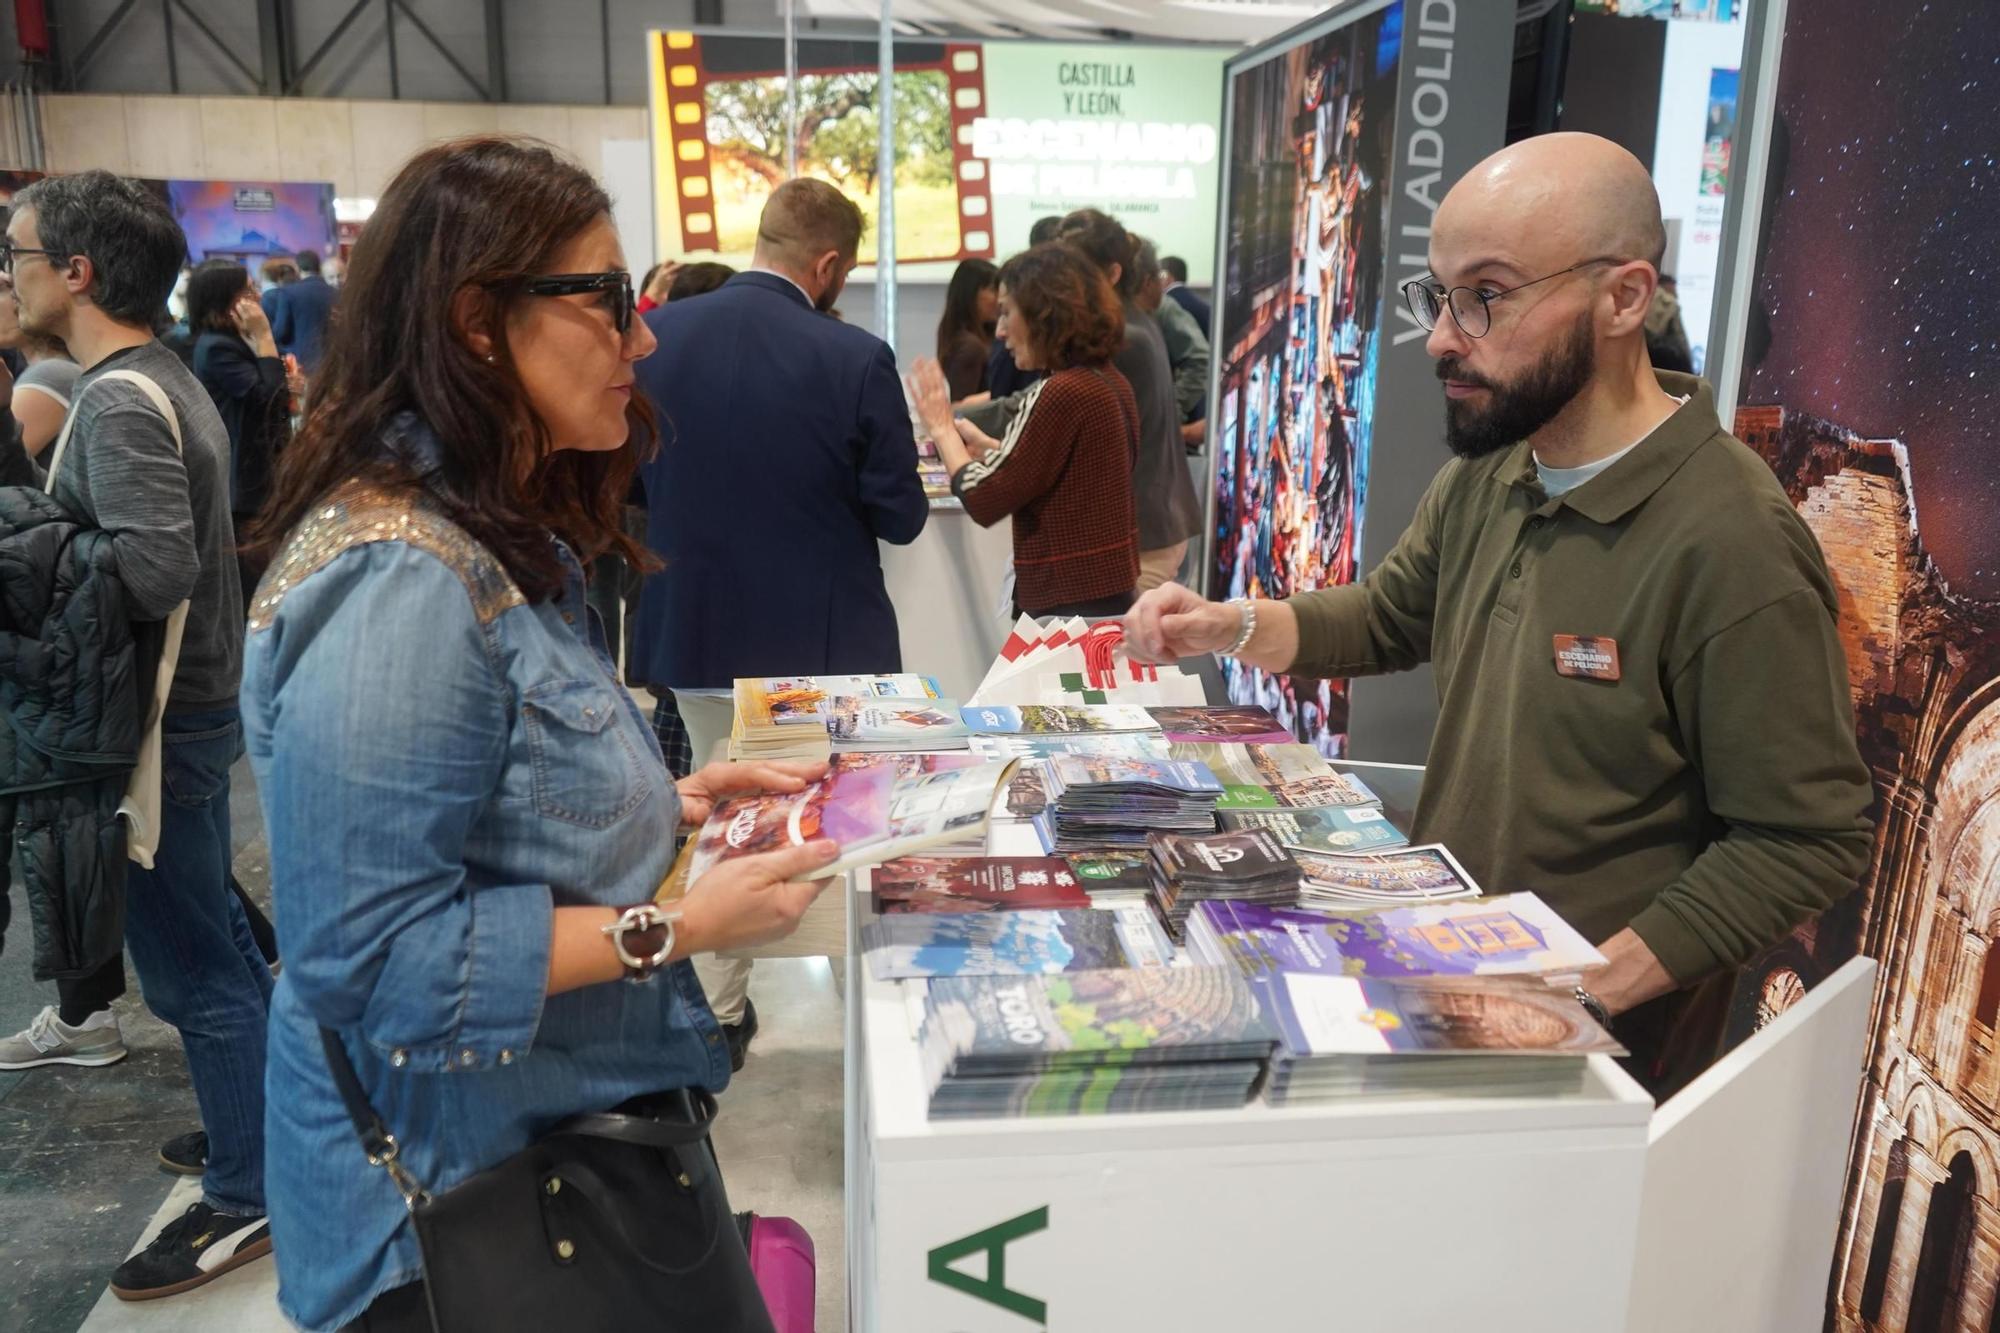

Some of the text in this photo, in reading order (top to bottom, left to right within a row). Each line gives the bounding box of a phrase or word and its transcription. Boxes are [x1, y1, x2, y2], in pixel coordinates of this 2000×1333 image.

[1058, 63, 1135, 86] CASTILLA
[1064, 88, 1126, 118] Y LEÓN,
[973, 117, 1216, 163] ESCENARIO
[991, 164, 1035, 195] DE
[1559, 651, 1612, 663] ESCENARIO
[996, 985, 1044, 1045] TORO
